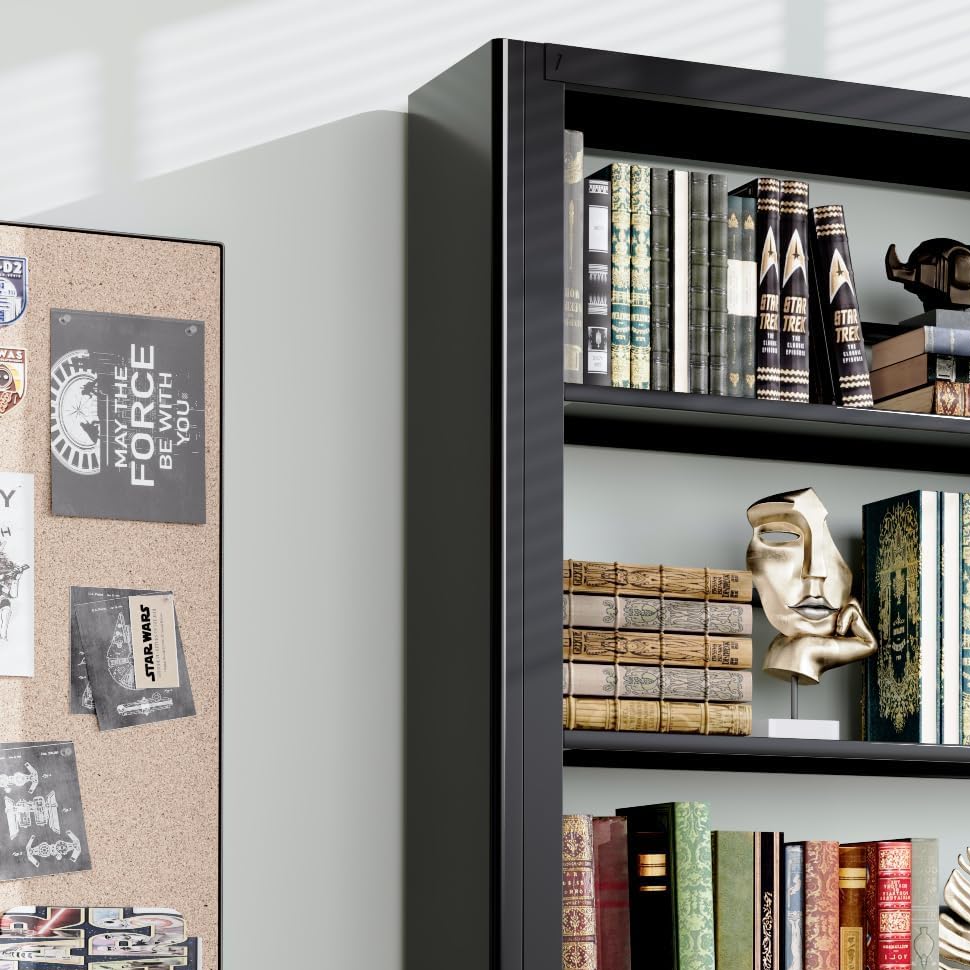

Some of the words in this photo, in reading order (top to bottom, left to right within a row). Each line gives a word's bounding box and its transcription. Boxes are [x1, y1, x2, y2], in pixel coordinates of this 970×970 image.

[783, 296, 807, 314] STAR
[783, 315, 807, 333] TREK
[834, 309, 858, 326] STAR
[835, 326, 860, 344] TREK
[114, 365, 128, 413] THE
[158, 372, 173, 432] WITH
[130, 343, 155, 487] FORCE
[176, 400, 190, 446] YOU
[114, 418, 128, 468] MAY
[159, 438, 173, 470] BE
[139, 604, 153, 643] WARS
[143, 643, 156, 682] STAR
